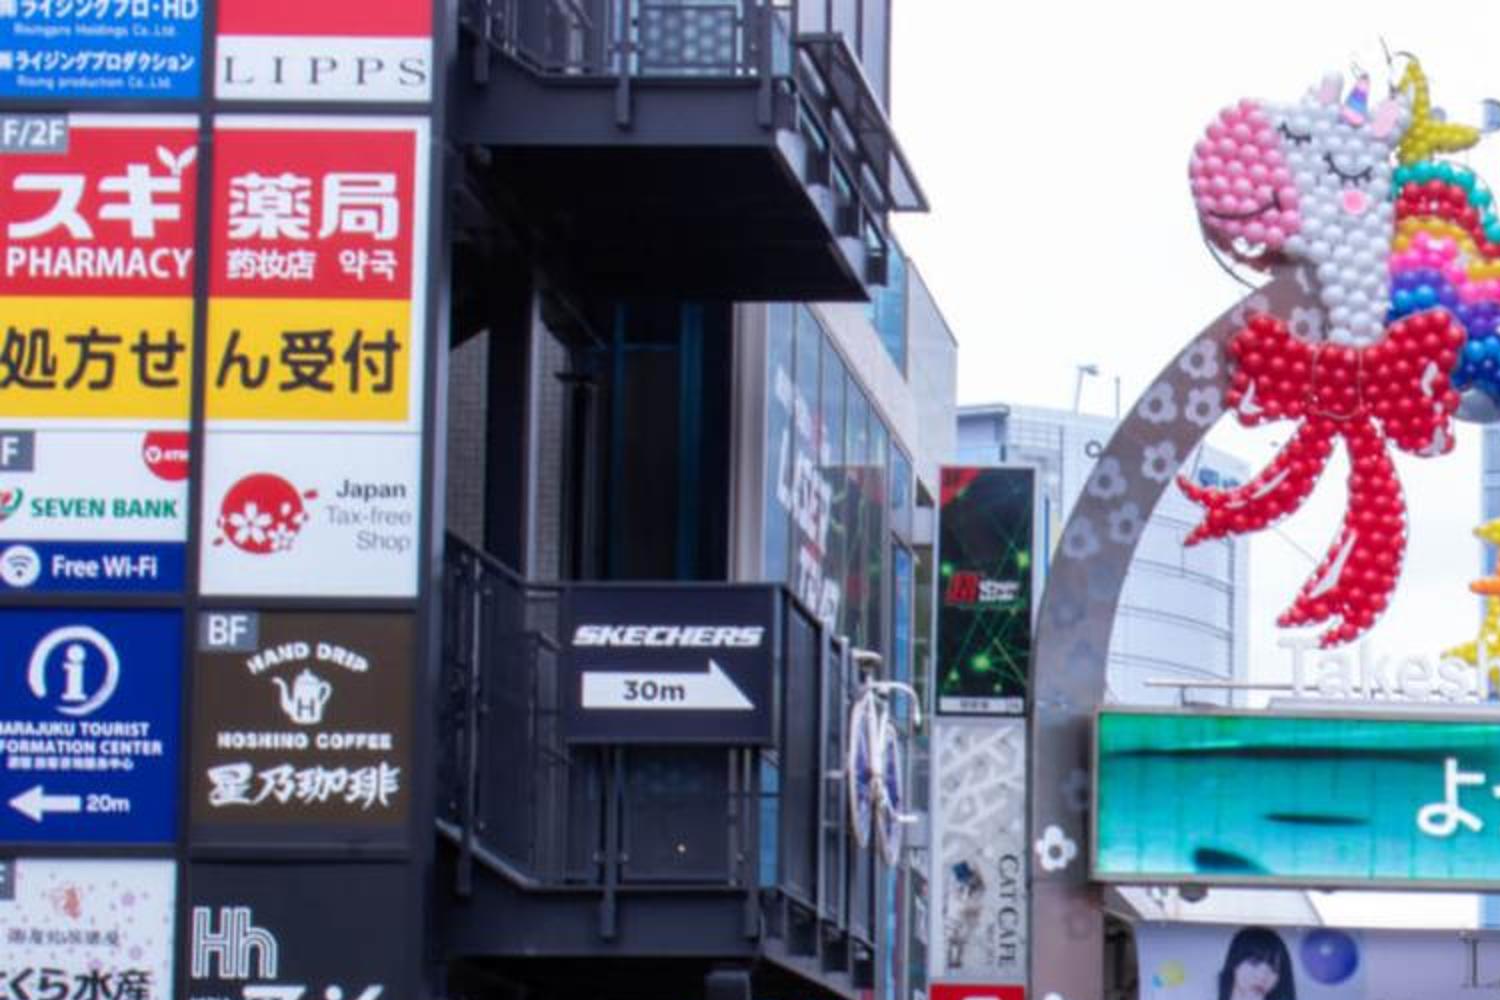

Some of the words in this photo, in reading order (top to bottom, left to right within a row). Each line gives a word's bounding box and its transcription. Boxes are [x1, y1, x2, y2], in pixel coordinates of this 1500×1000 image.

[222, 55, 428, 87] LIPPS
[6, 247, 194, 279] PHARMACY
[336, 480, 407, 500] Japan
[31, 498, 106, 518] SEVEN
[112, 498, 178, 518] BANK
[327, 506, 412, 527] Tax-free
[356, 531, 411, 554] Shop
[52, 555, 99, 578] Free
[104, 554, 157, 578] Wi-Fi
[207, 616, 250, 646] BF
[572, 624, 765, 648] SKECHERS
[246, 641, 310, 675] HAND
[314, 642, 370, 673] DRIP
[622, 680, 686, 701] 30m
[79, 721, 150, 736] TOURIST
[99, 740, 164, 756] CENTER
[216, 731, 309, 750] HOSHINO
[315, 731, 392, 750] COFFEE
[85, 793, 131, 812] 20m
